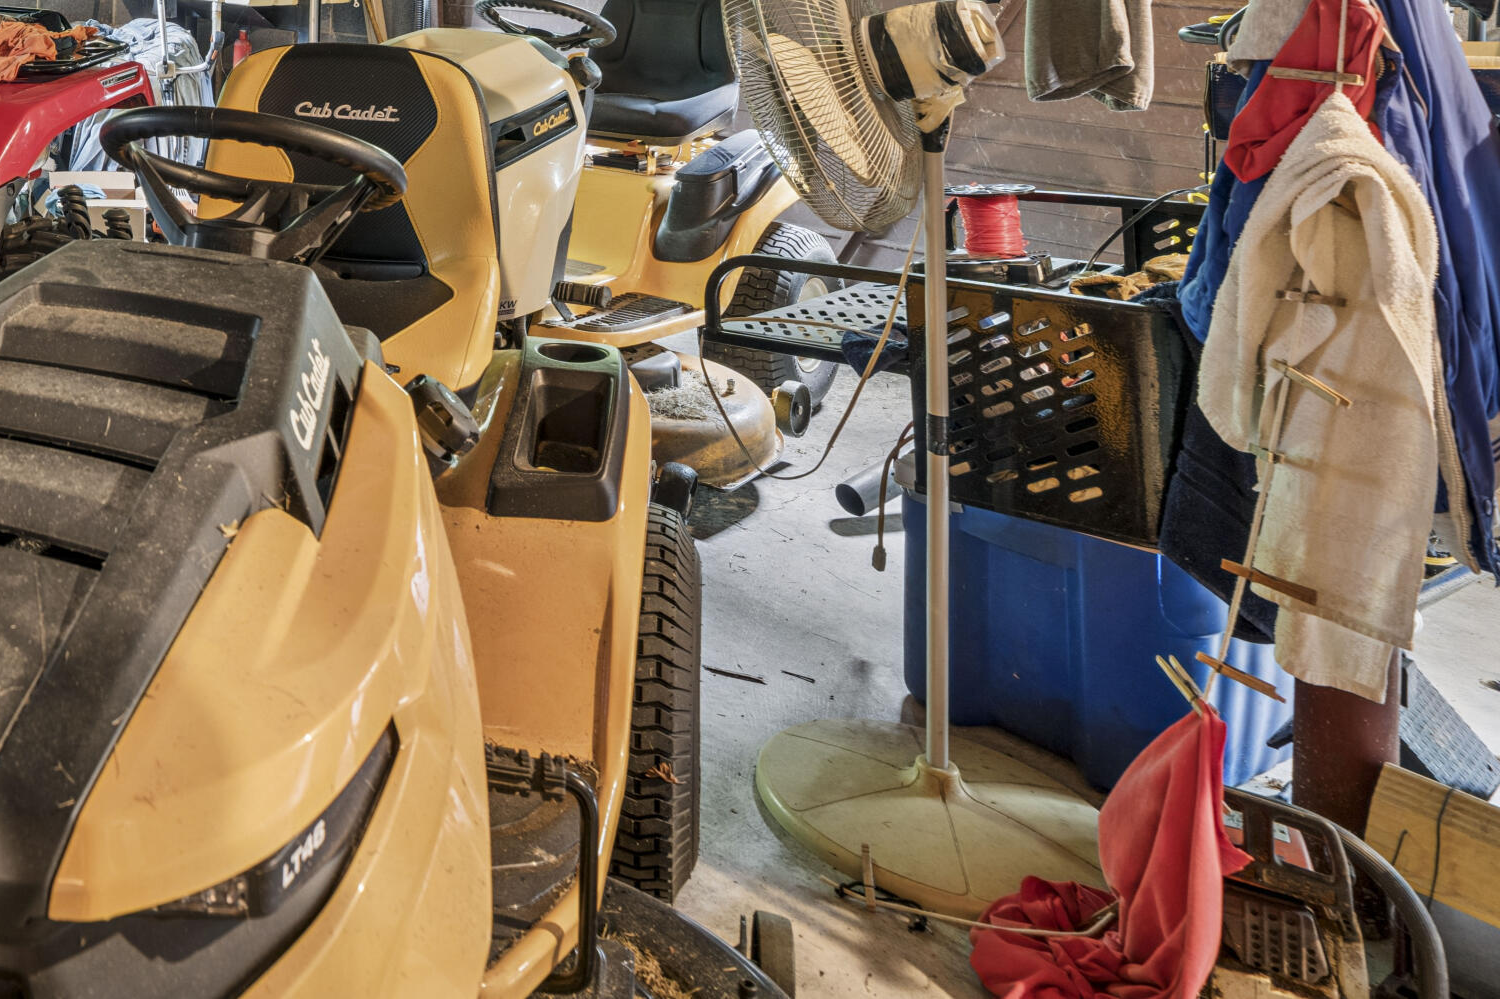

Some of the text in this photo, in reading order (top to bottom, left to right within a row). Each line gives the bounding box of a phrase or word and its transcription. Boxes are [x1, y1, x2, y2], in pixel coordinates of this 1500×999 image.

[294, 101, 400, 122] Cub Cadet
[533, 108, 570, 137] Cub Cadet
[290, 338, 330, 450] Cub Cadet
